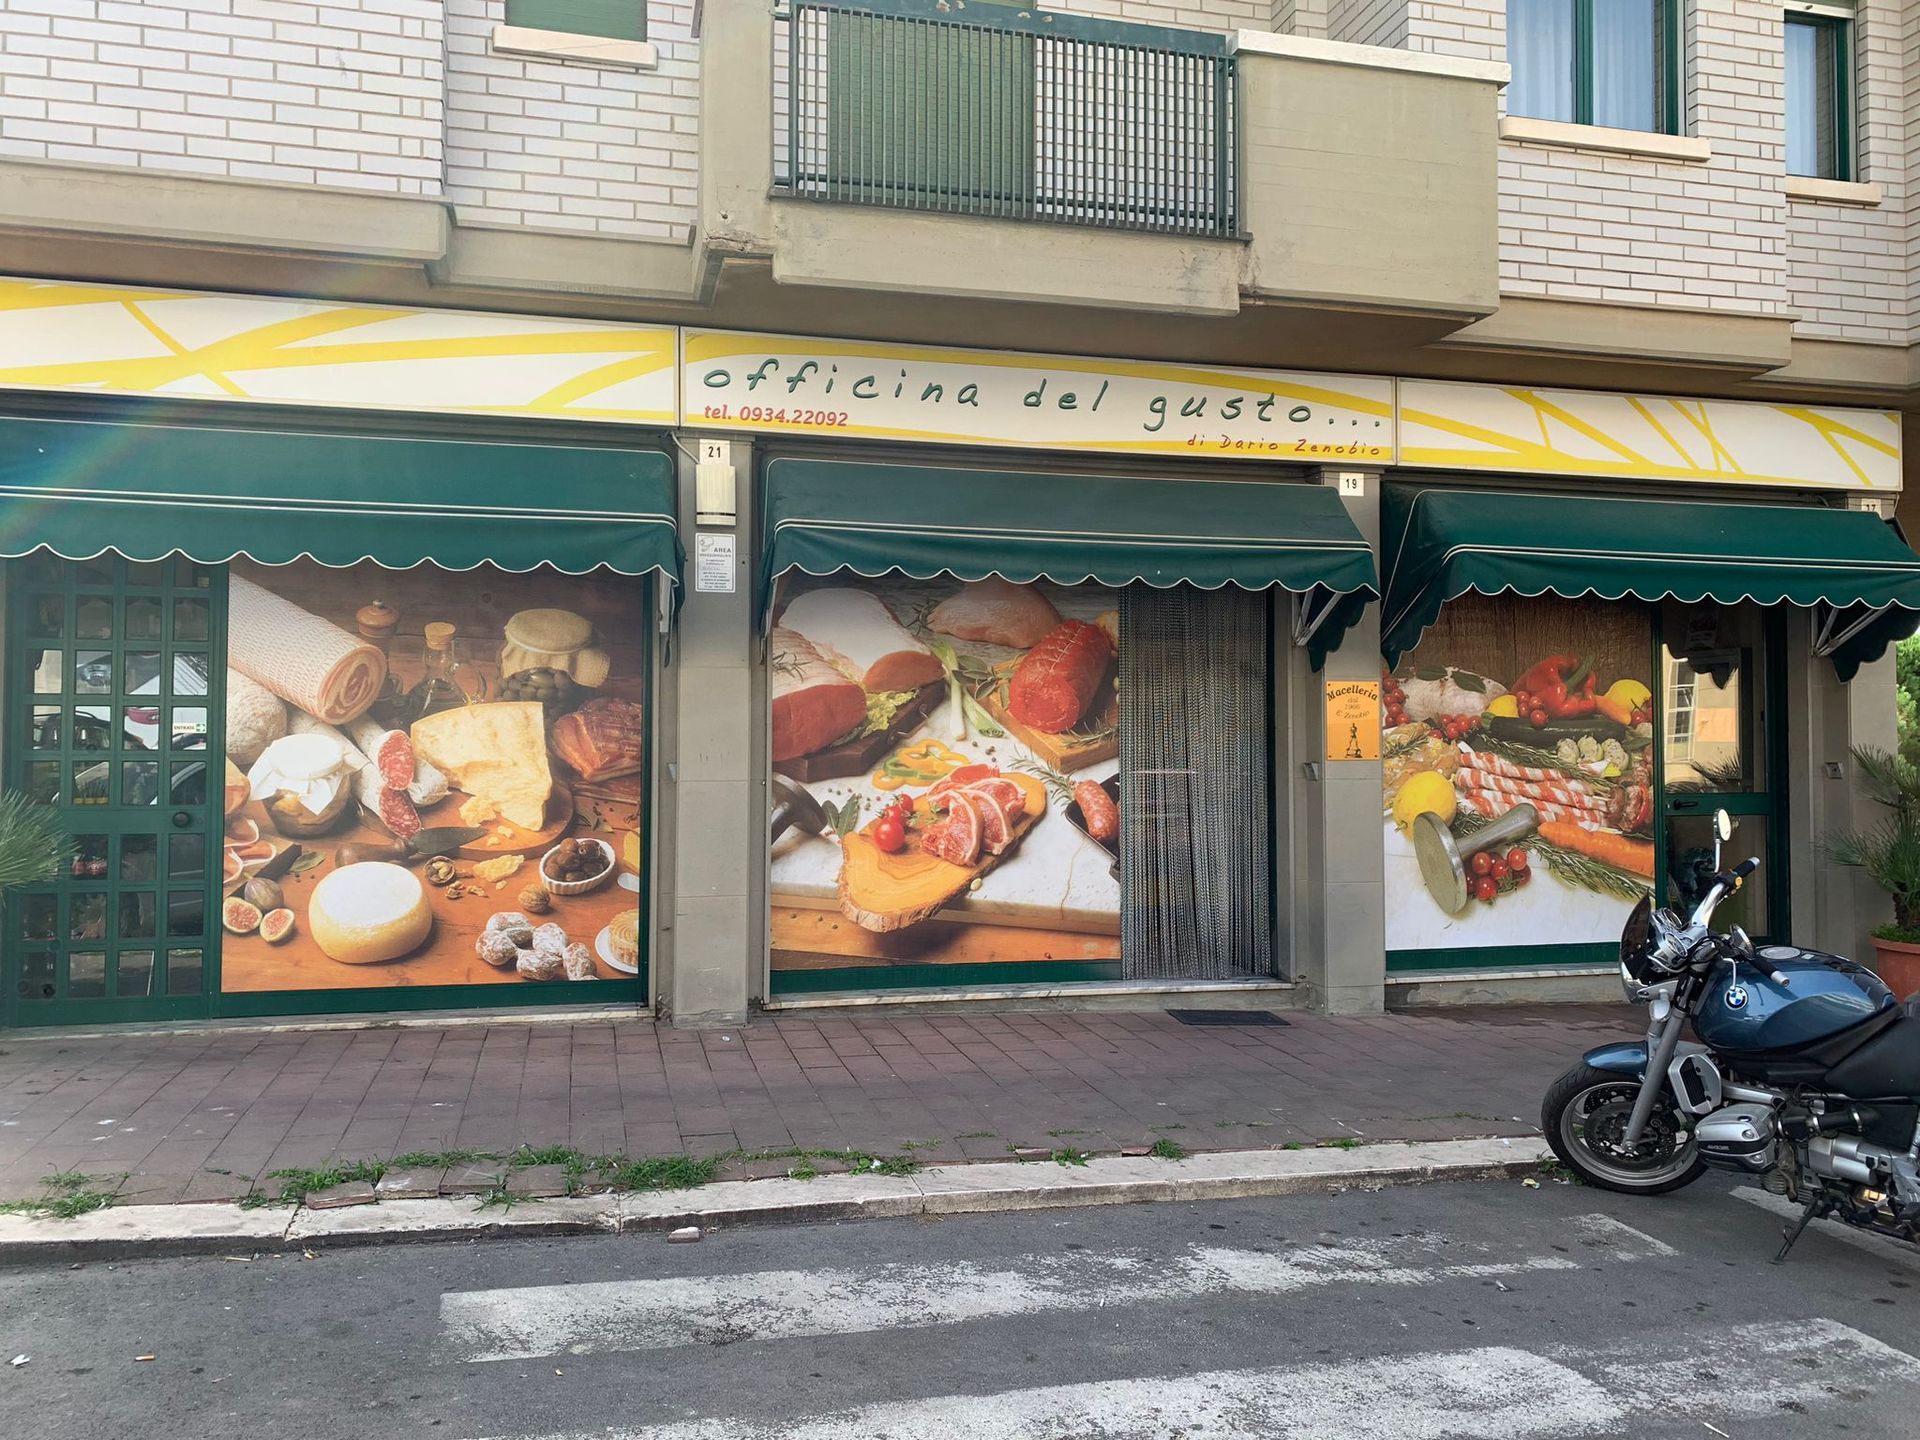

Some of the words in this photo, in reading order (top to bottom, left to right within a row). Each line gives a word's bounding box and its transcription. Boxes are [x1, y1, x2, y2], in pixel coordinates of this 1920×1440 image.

[703, 358, 979, 407] officina
[1023, 378, 1109, 411] del
[704, 404, 732, 421] tel.
[739, 406, 849, 428] 0934.22092
[708, 446, 721, 458] 21
[1187, 434, 1205, 447] di
[1219, 434, 1280, 451] Dario
[1294, 438, 1381, 456] Zenobio
[1345, 478, 1358, 490] 19
[1327, 685, 1378, 702] Macelleria
